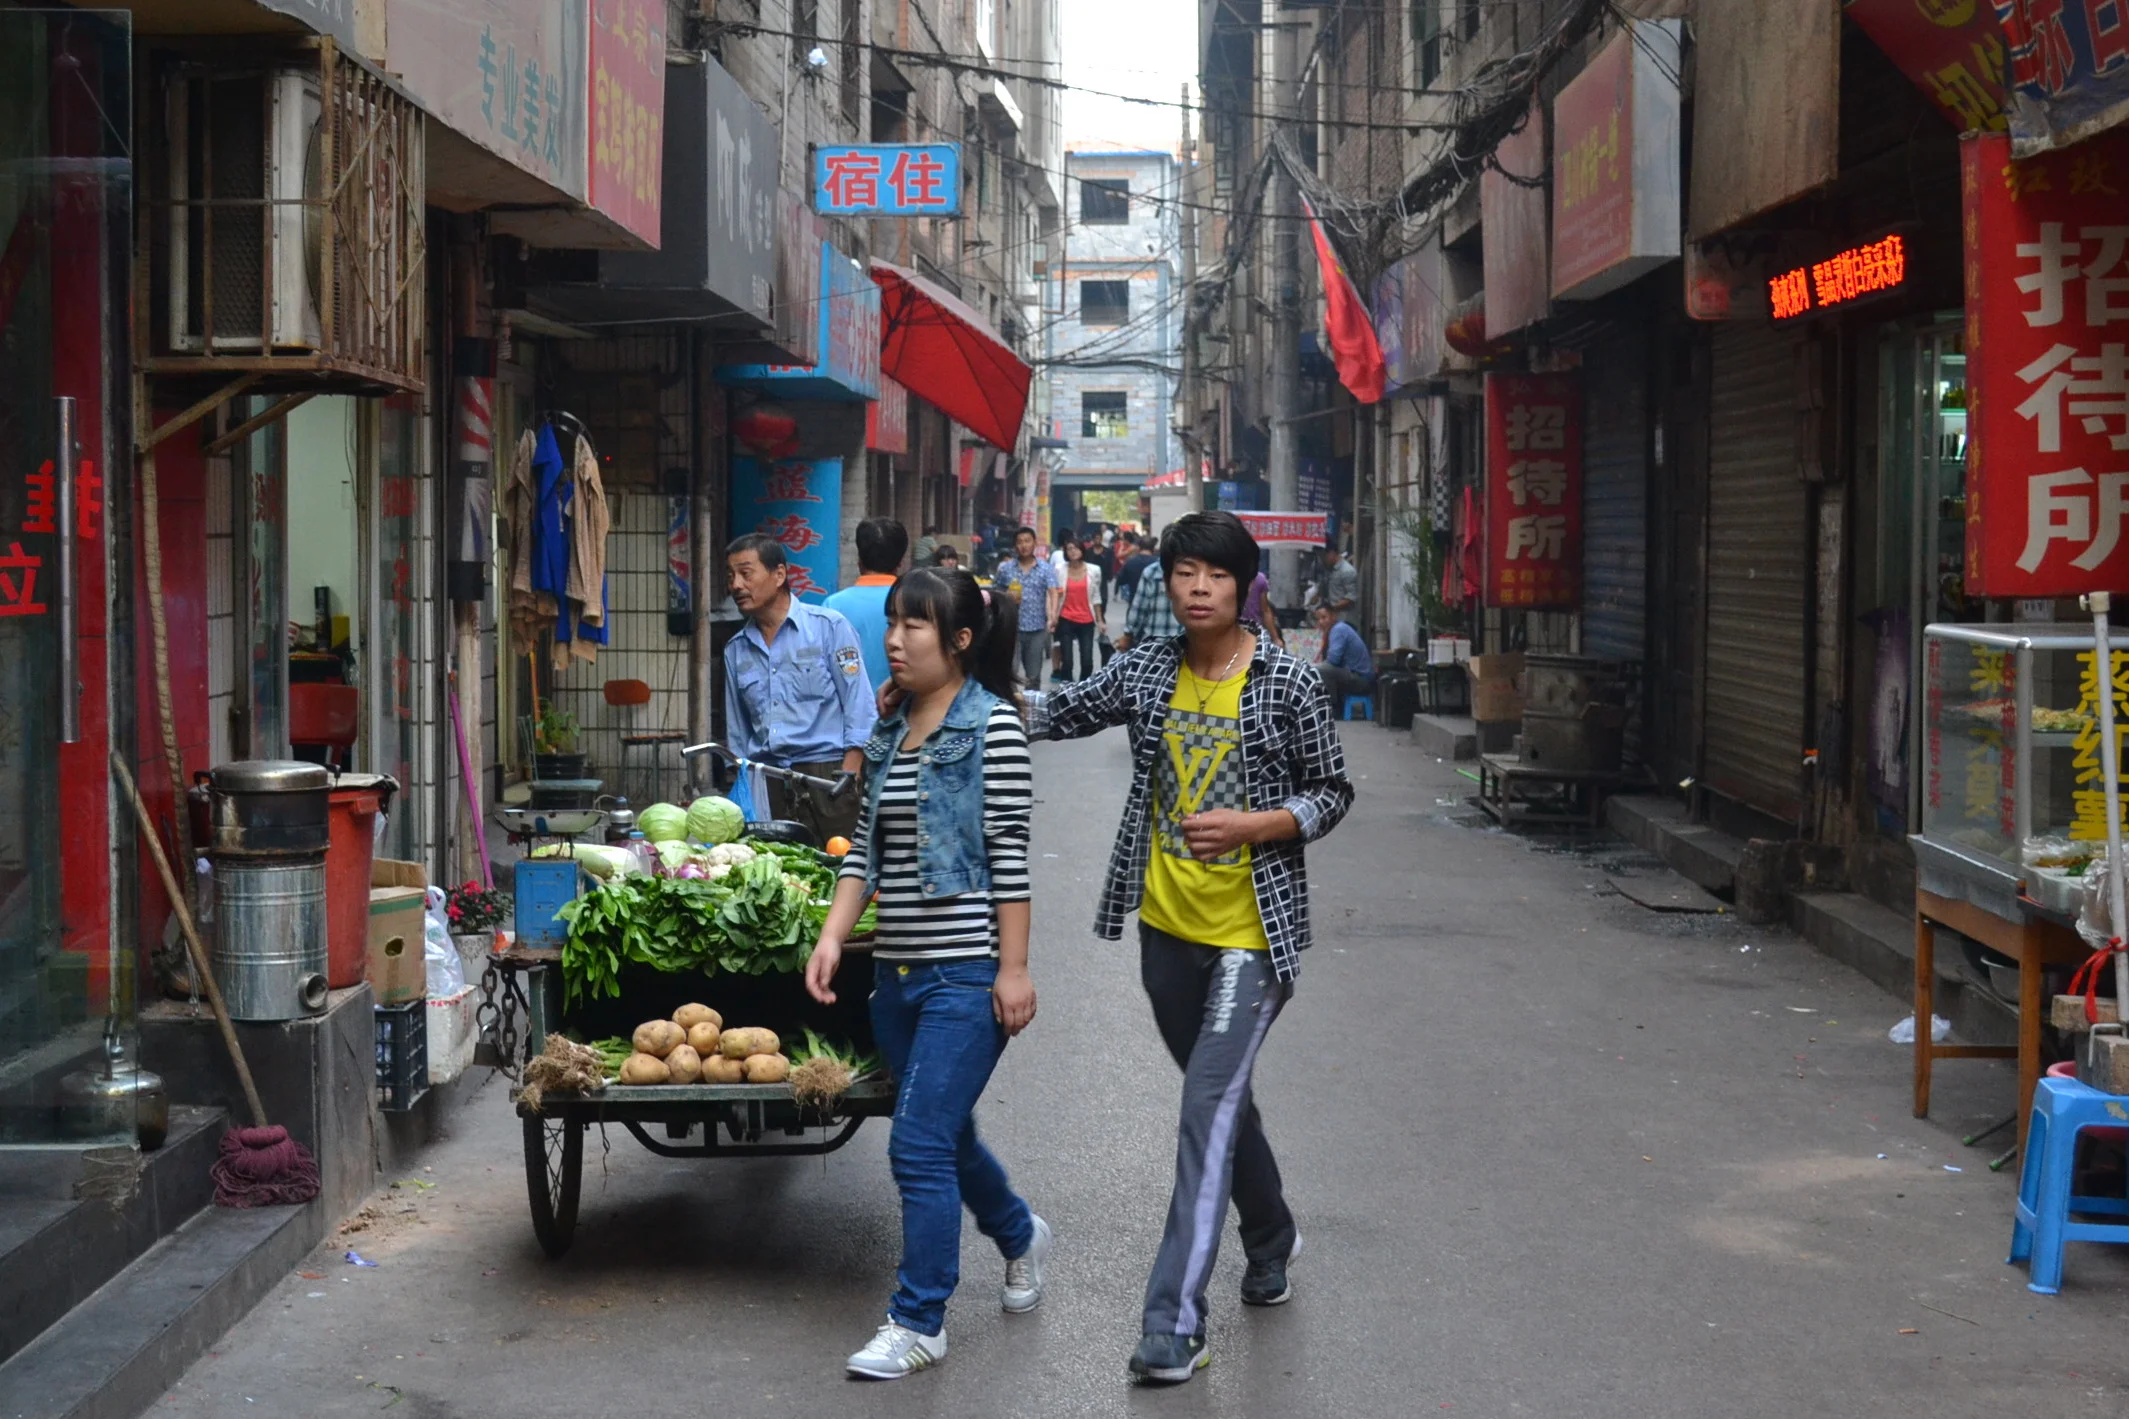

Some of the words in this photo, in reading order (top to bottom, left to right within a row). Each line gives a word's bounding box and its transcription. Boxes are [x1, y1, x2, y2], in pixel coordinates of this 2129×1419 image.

[478, 23, 562, 178] 专业美发
[2013, 222, 2129, 575] 招待所
[1505, 403, 1568, 561] 招待所
